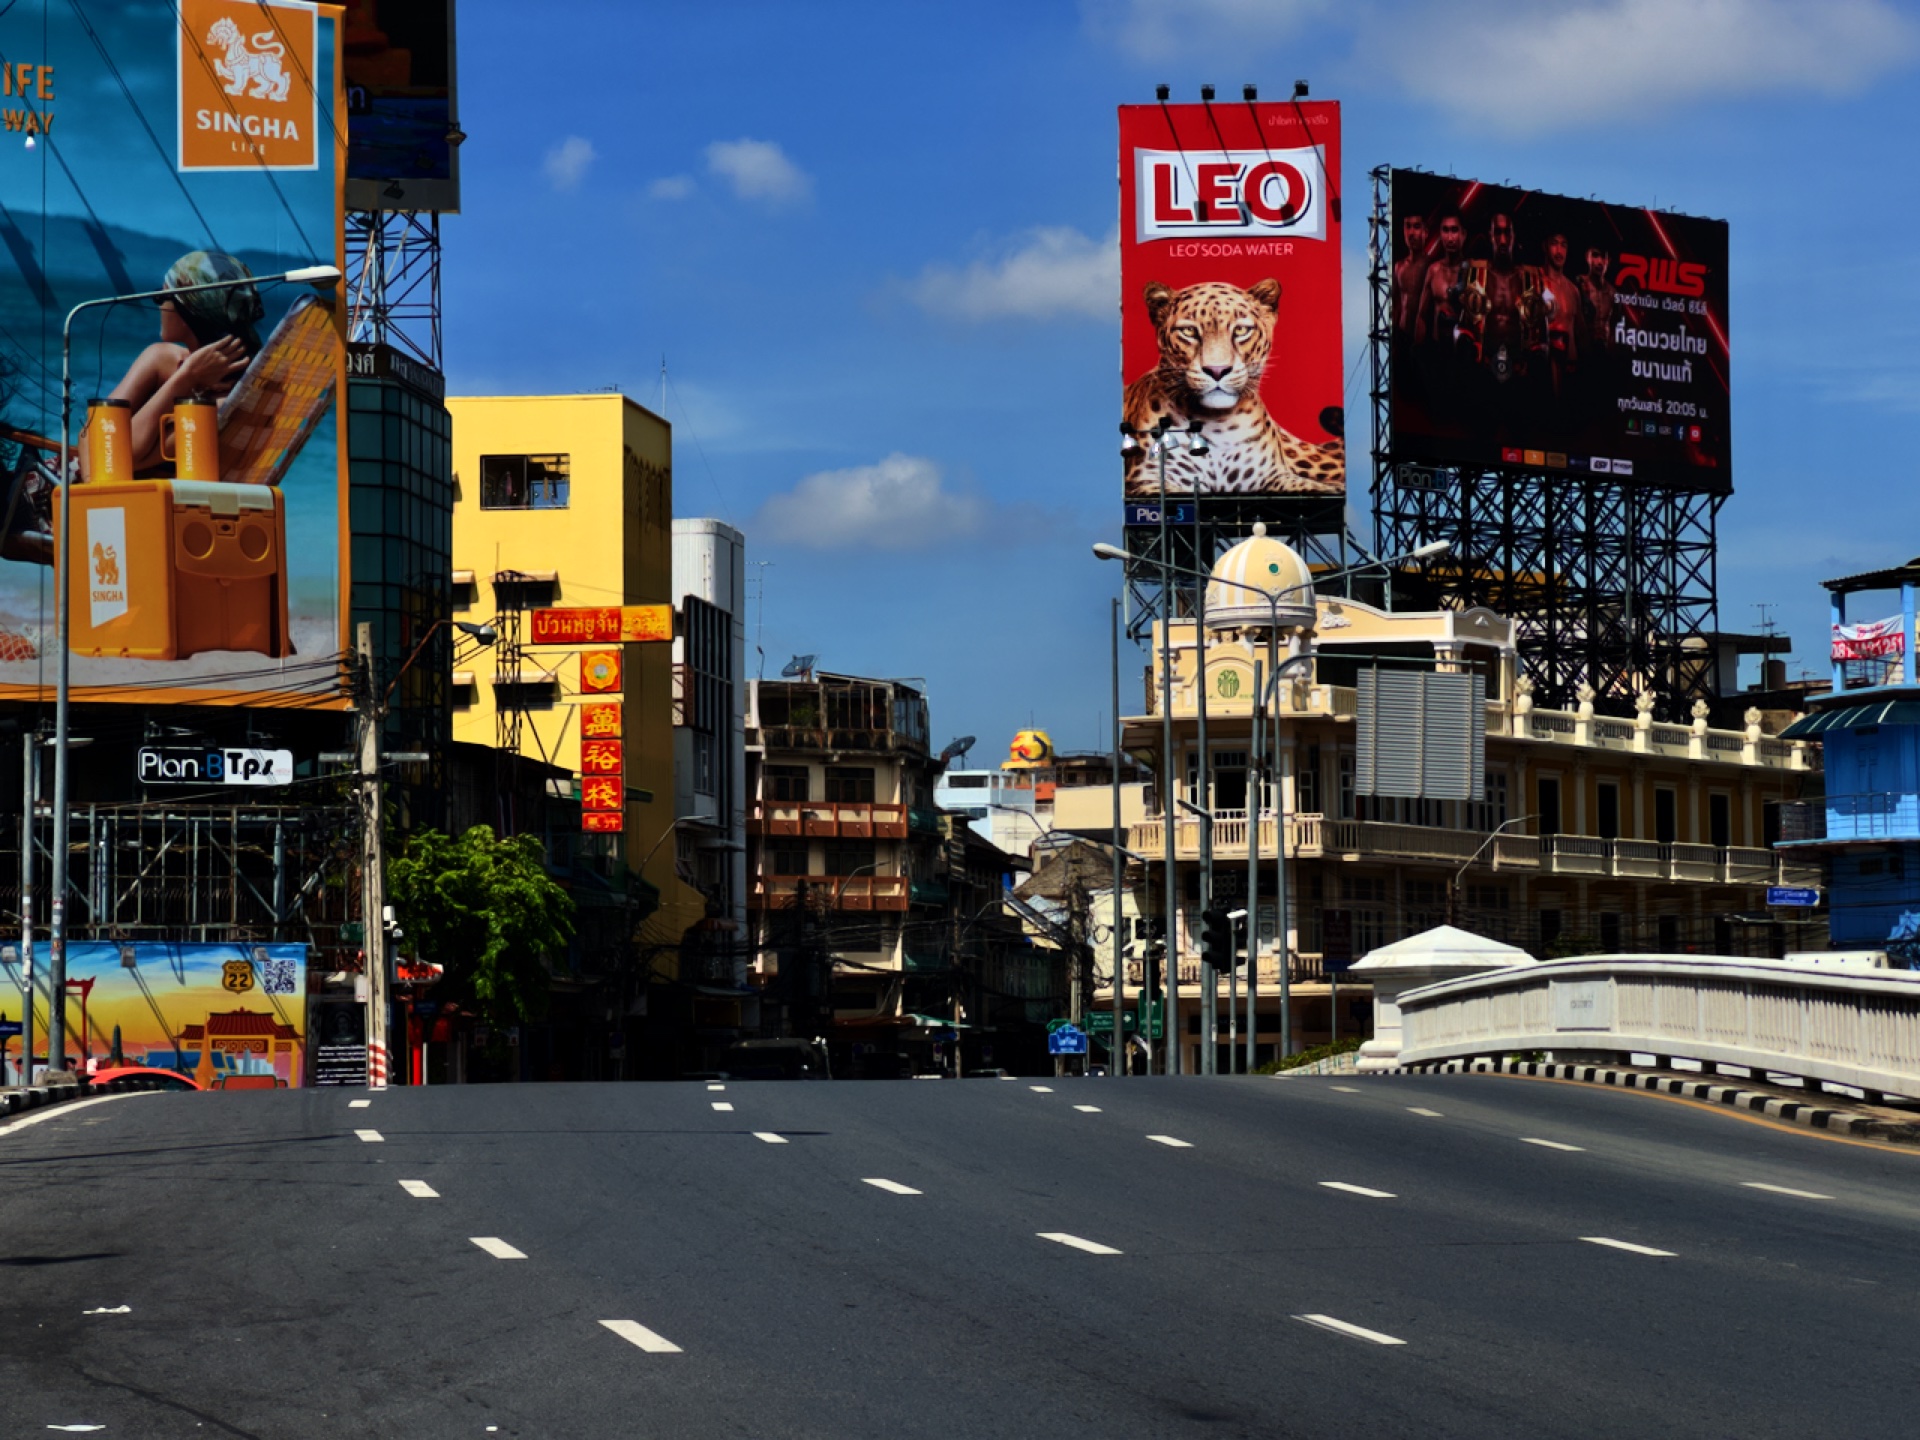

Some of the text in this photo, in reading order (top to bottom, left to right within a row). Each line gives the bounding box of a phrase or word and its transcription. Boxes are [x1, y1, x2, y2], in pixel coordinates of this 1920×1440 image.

[3, 107, 54, 135] WAY
[196, 108, 299, 141] SINGHA
[231, 140, 265, 155] LIFE
[1153, 160, 1312, 228] LEO
[1202, 245, 1243, 257] SODA
[1246, 243, 1293, 256] WATER
[1614, 253, 1706, 297] RWS
[1614, 316, 1707, 355] ที่สุดมวยไทย
[1631, 358, 1692, 383] ขนานแท้
[1666, 400, 1696, 417] 20:05
[1136, 507, 1164, 523] Pla
[92, 590, 124, 603] SINGHA
[141, 752, 199, 778] Plan
[228, 973, 249, 988] 22
